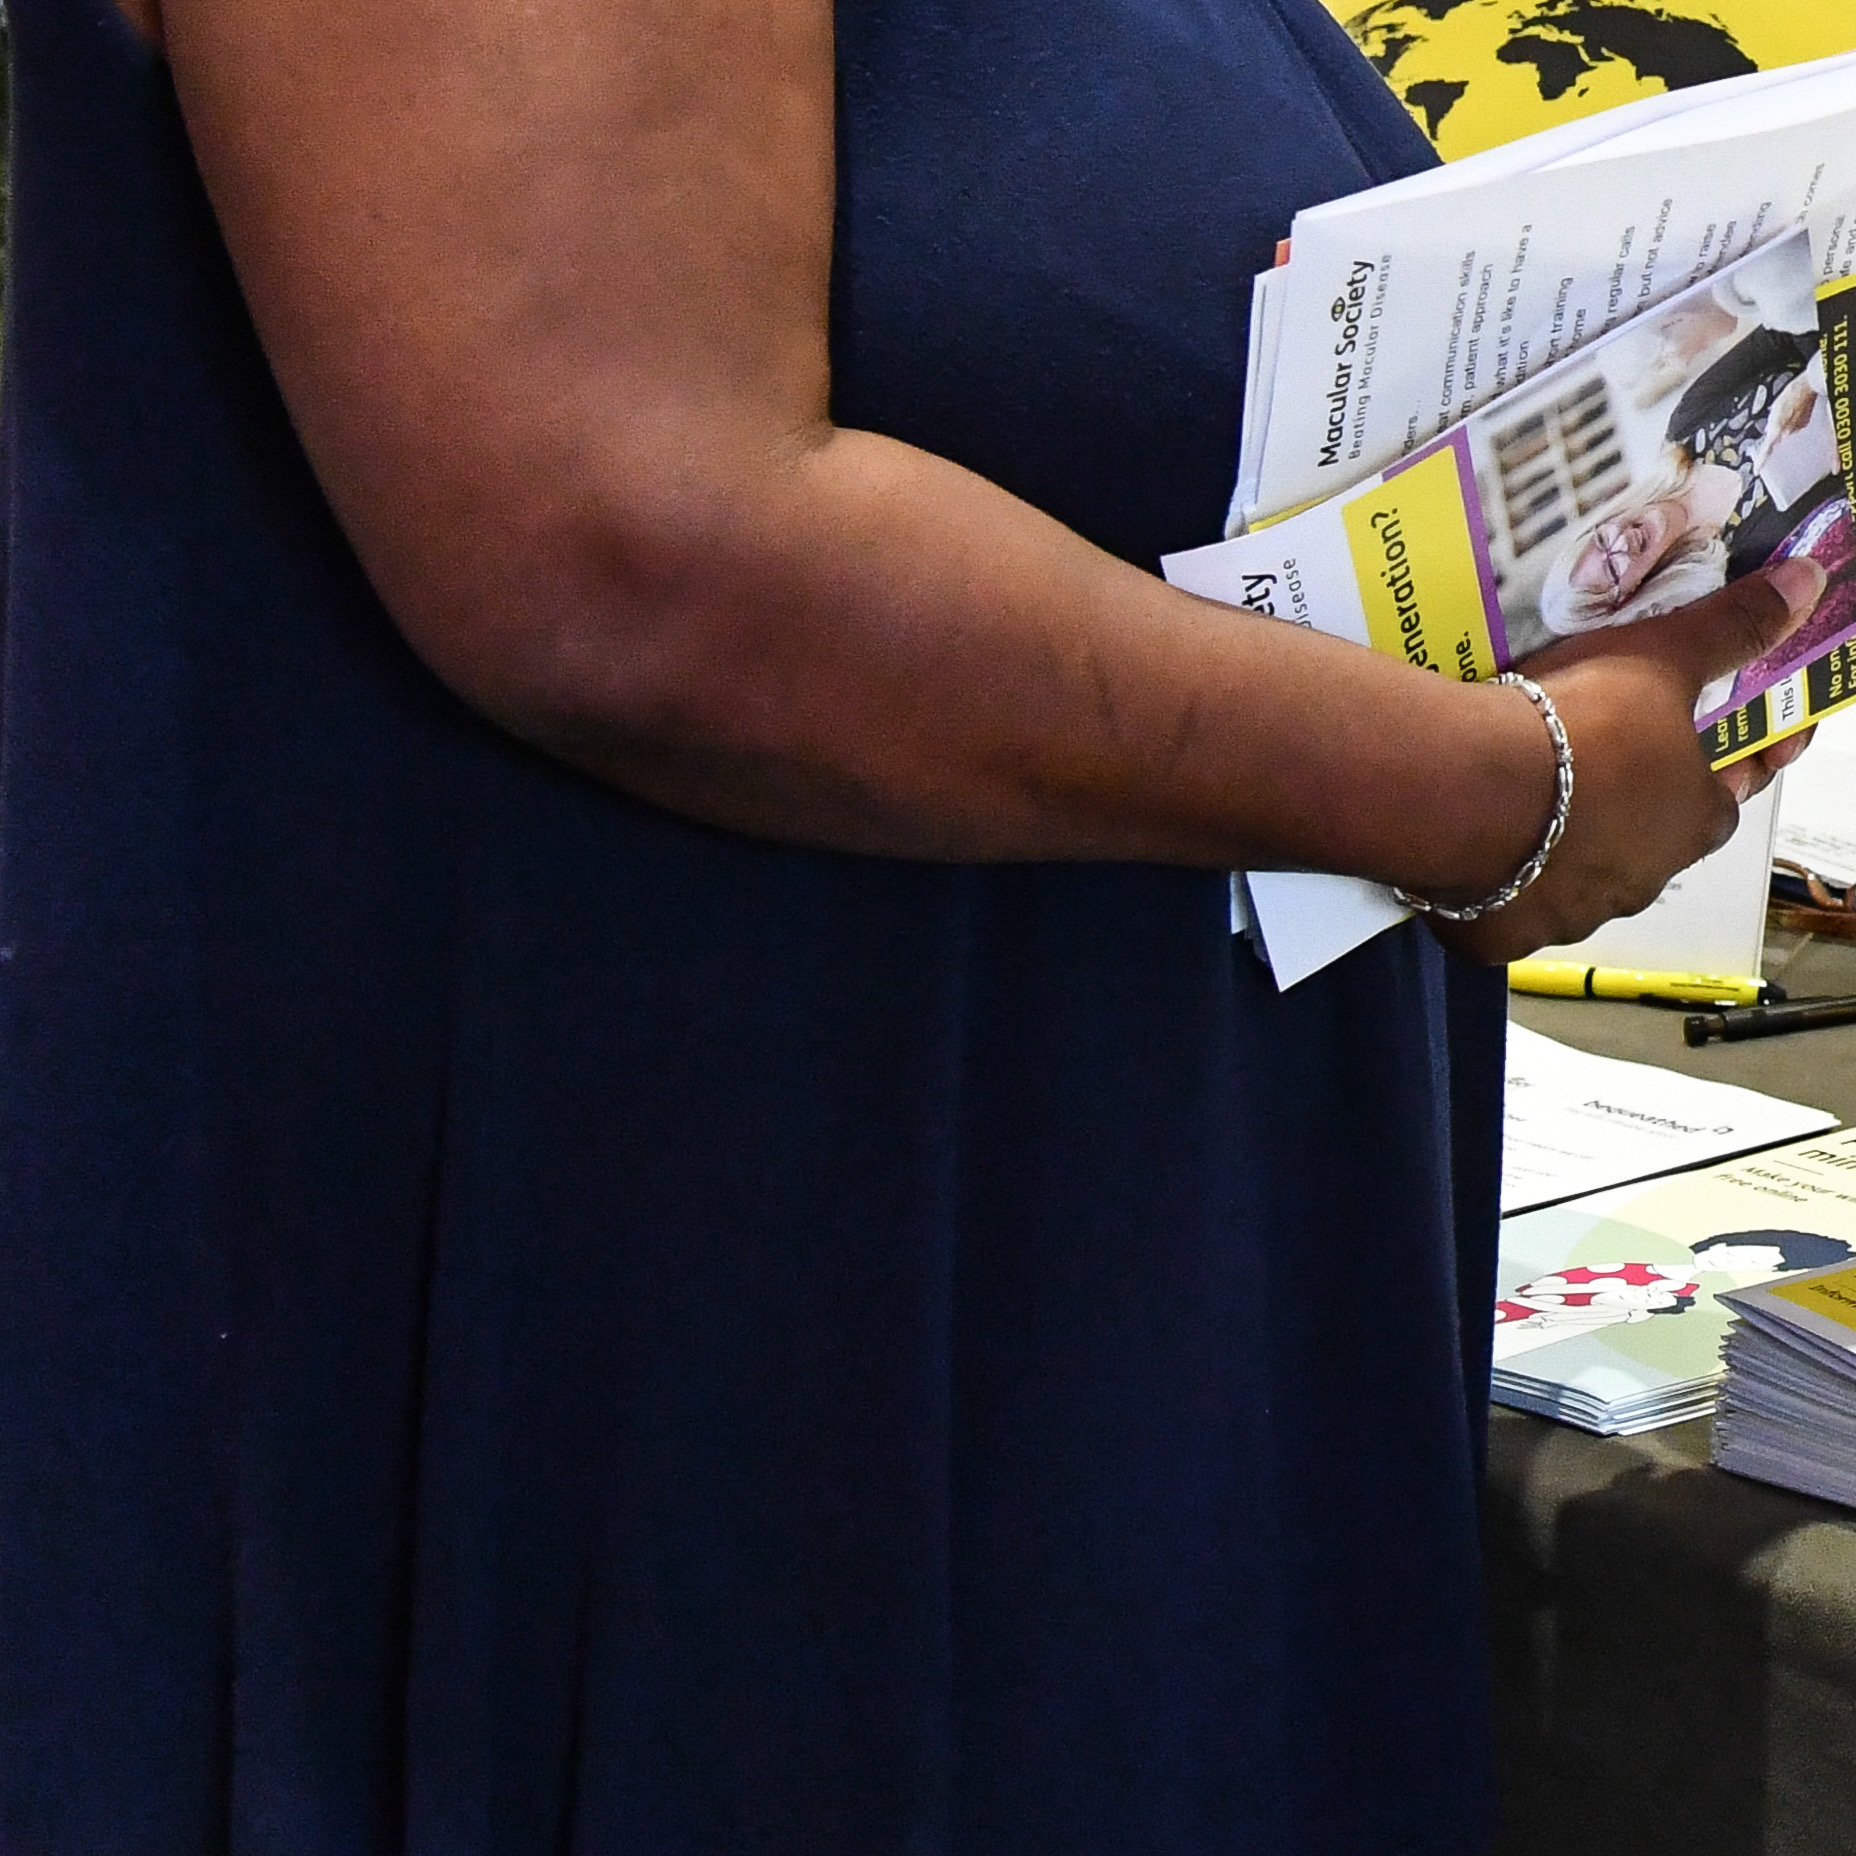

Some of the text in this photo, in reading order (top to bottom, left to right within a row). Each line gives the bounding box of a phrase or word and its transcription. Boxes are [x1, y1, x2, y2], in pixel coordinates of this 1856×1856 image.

[1316, 259, 1376, 468] Macular Society
[1346, 253, 1393, 460] Beating Macular Disease
[1833, 315, 1852, 469] call 0300 3030 111.
